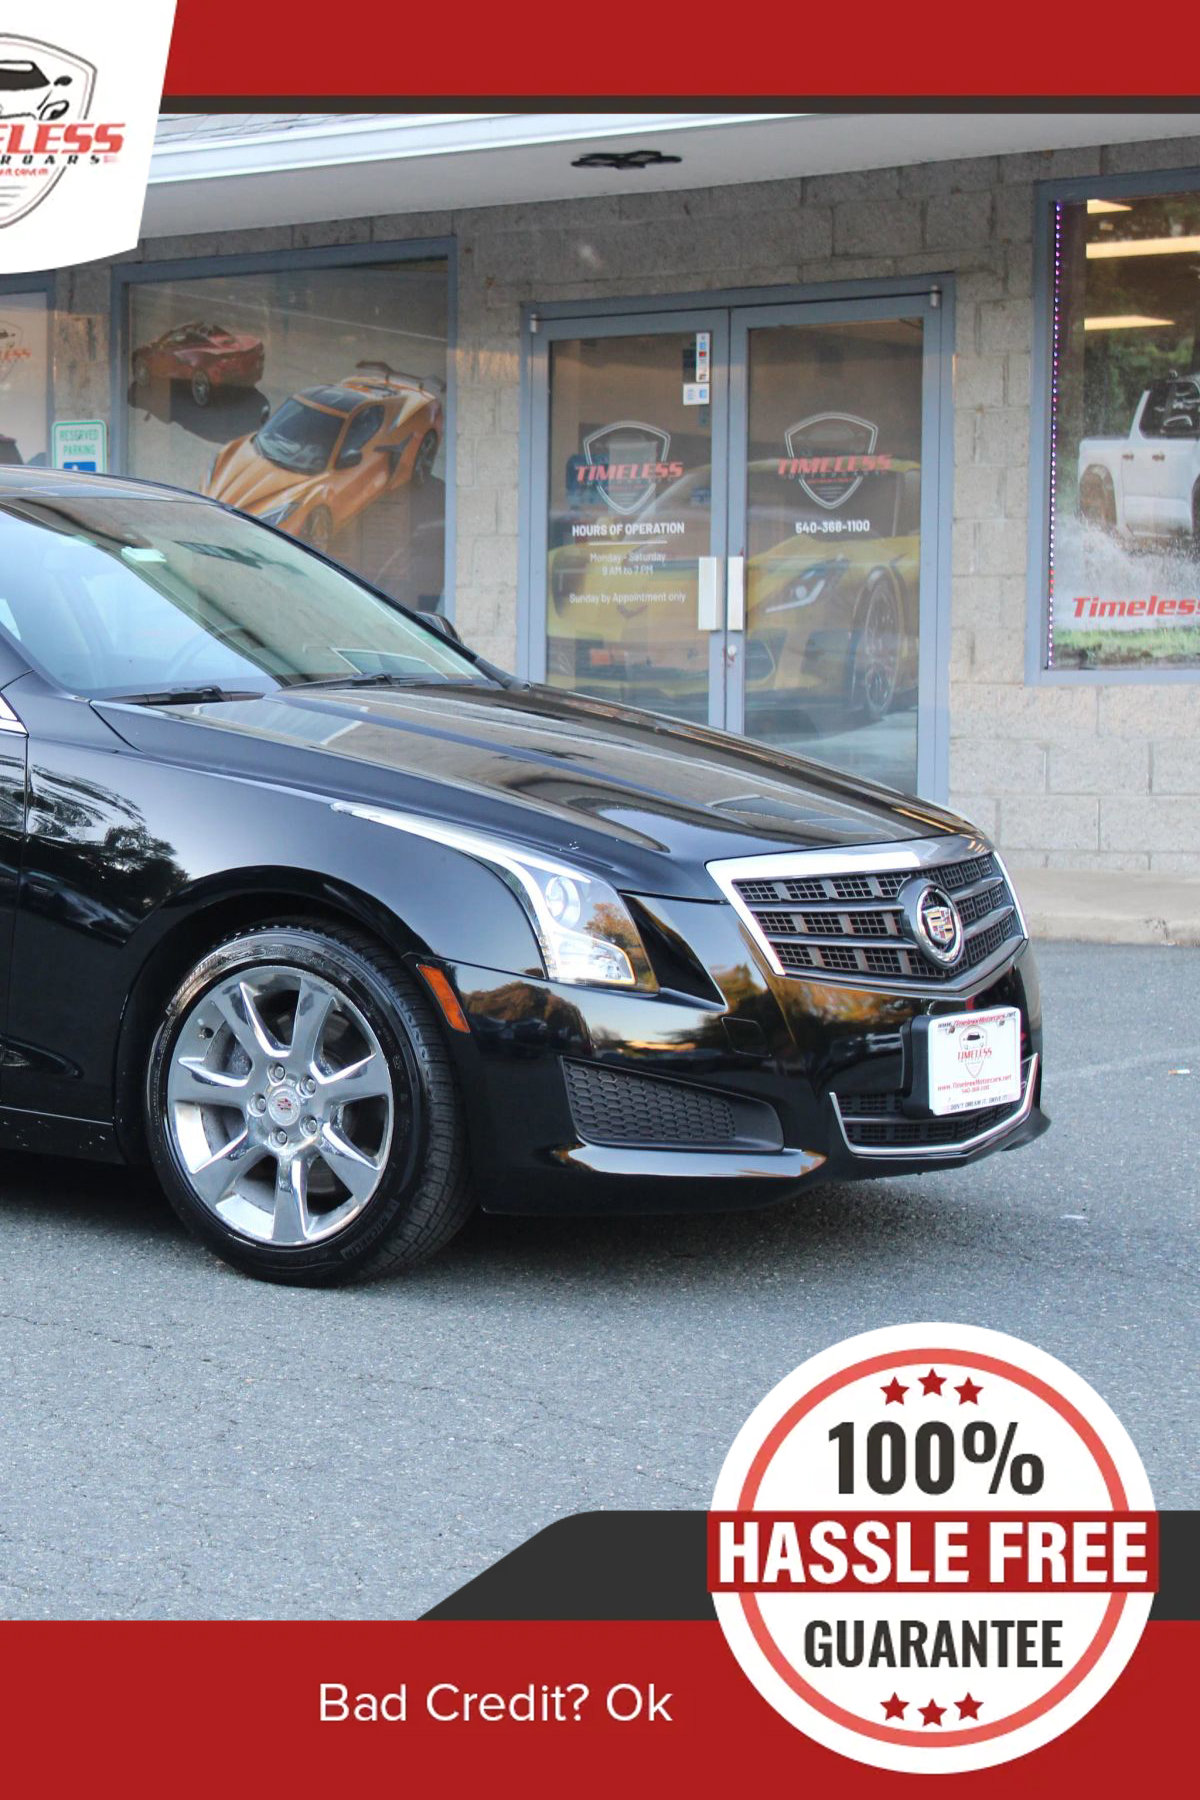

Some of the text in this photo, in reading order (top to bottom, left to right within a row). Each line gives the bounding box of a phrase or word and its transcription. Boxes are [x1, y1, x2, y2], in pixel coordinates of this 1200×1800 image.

[60, 429, 99, 441] RESERVED
[63, 444, 96, 456] PARKING
[778, 454, 893, 475] TIMELESS
[576, 462, 684, 482] TIMELESS
[571, 522, 685, 536] HOURS OF OPERATION
[795, 520, 870, 534] 540-368-1100
[590, 553, 621, 564] Monday
[629, 552, 666, 563] Saturday
[608, 566, 621, 576] AM
[623, 566, 632, 575] to
[641, 565, 653, 575] PM
[569, 591, 687, 605] Sunday by Appointment only
[1072, 596, 1200, 619] Timeles
